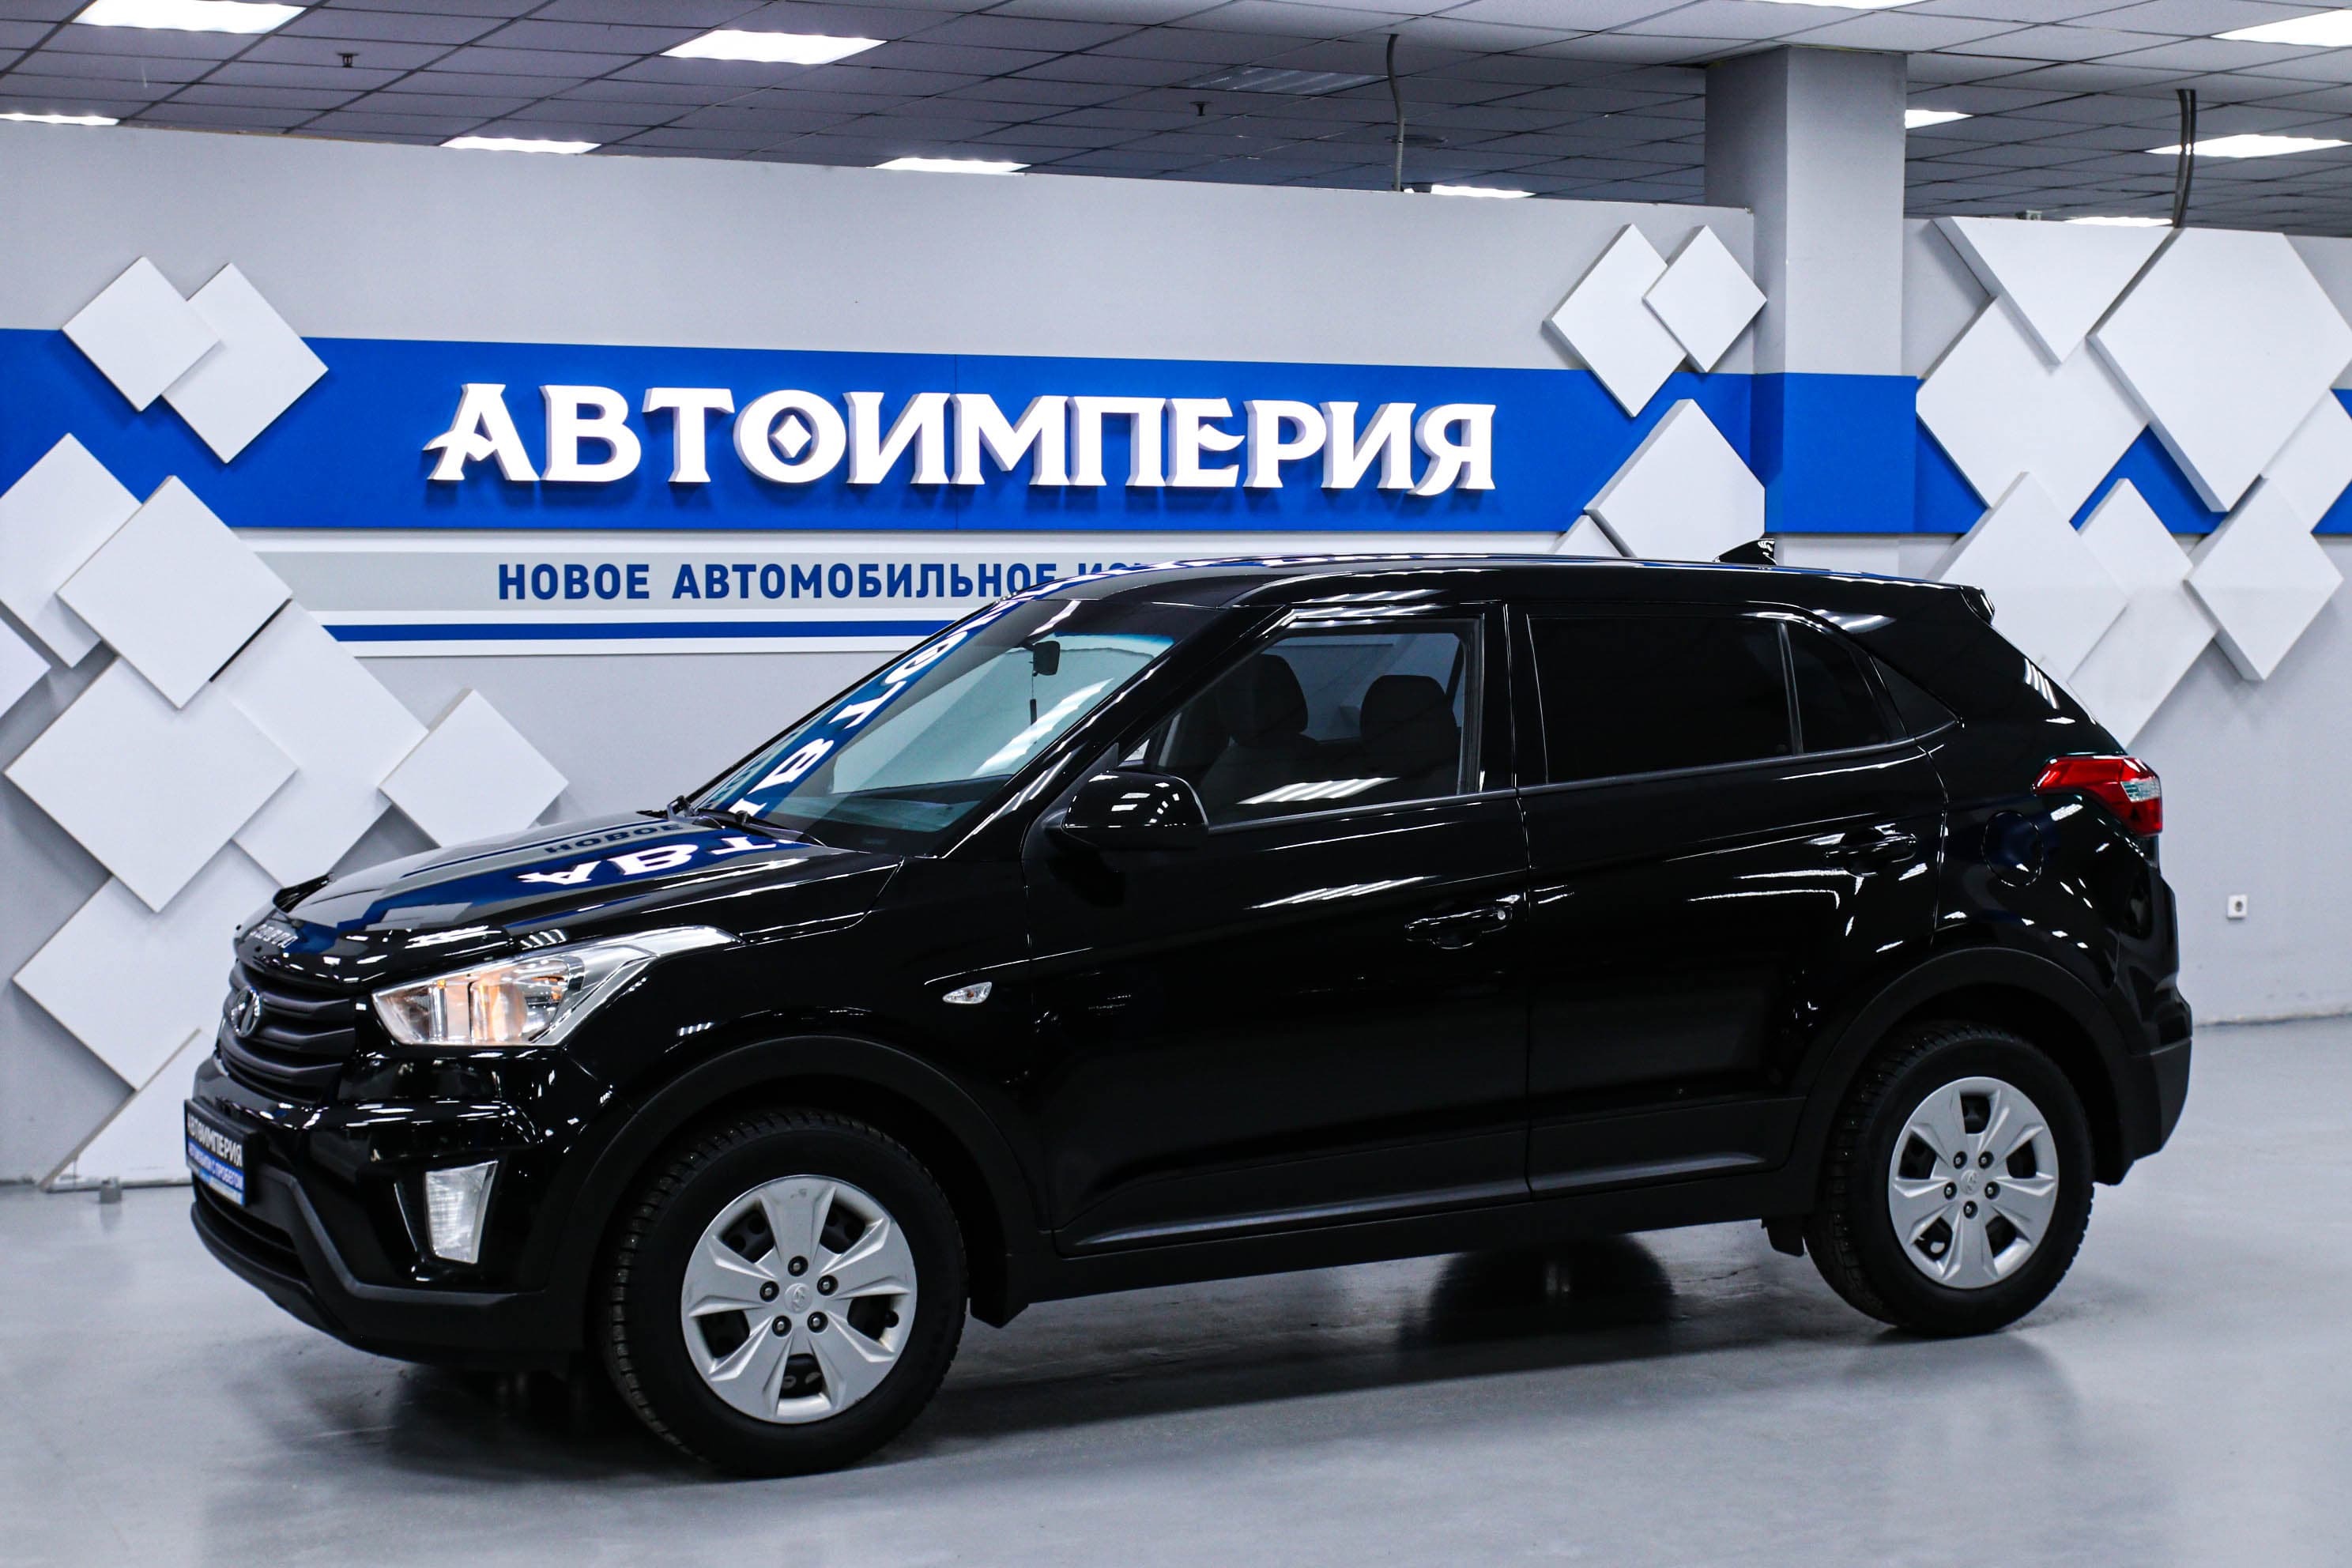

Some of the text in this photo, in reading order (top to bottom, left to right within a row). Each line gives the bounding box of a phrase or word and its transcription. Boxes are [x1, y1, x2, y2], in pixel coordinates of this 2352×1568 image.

[423, 383, 1495, 496] АВТОИМПЕРИЯ
[499, 562, 1057, 601] НОВОЕ АВТОМОБИЛЬНОЕ
